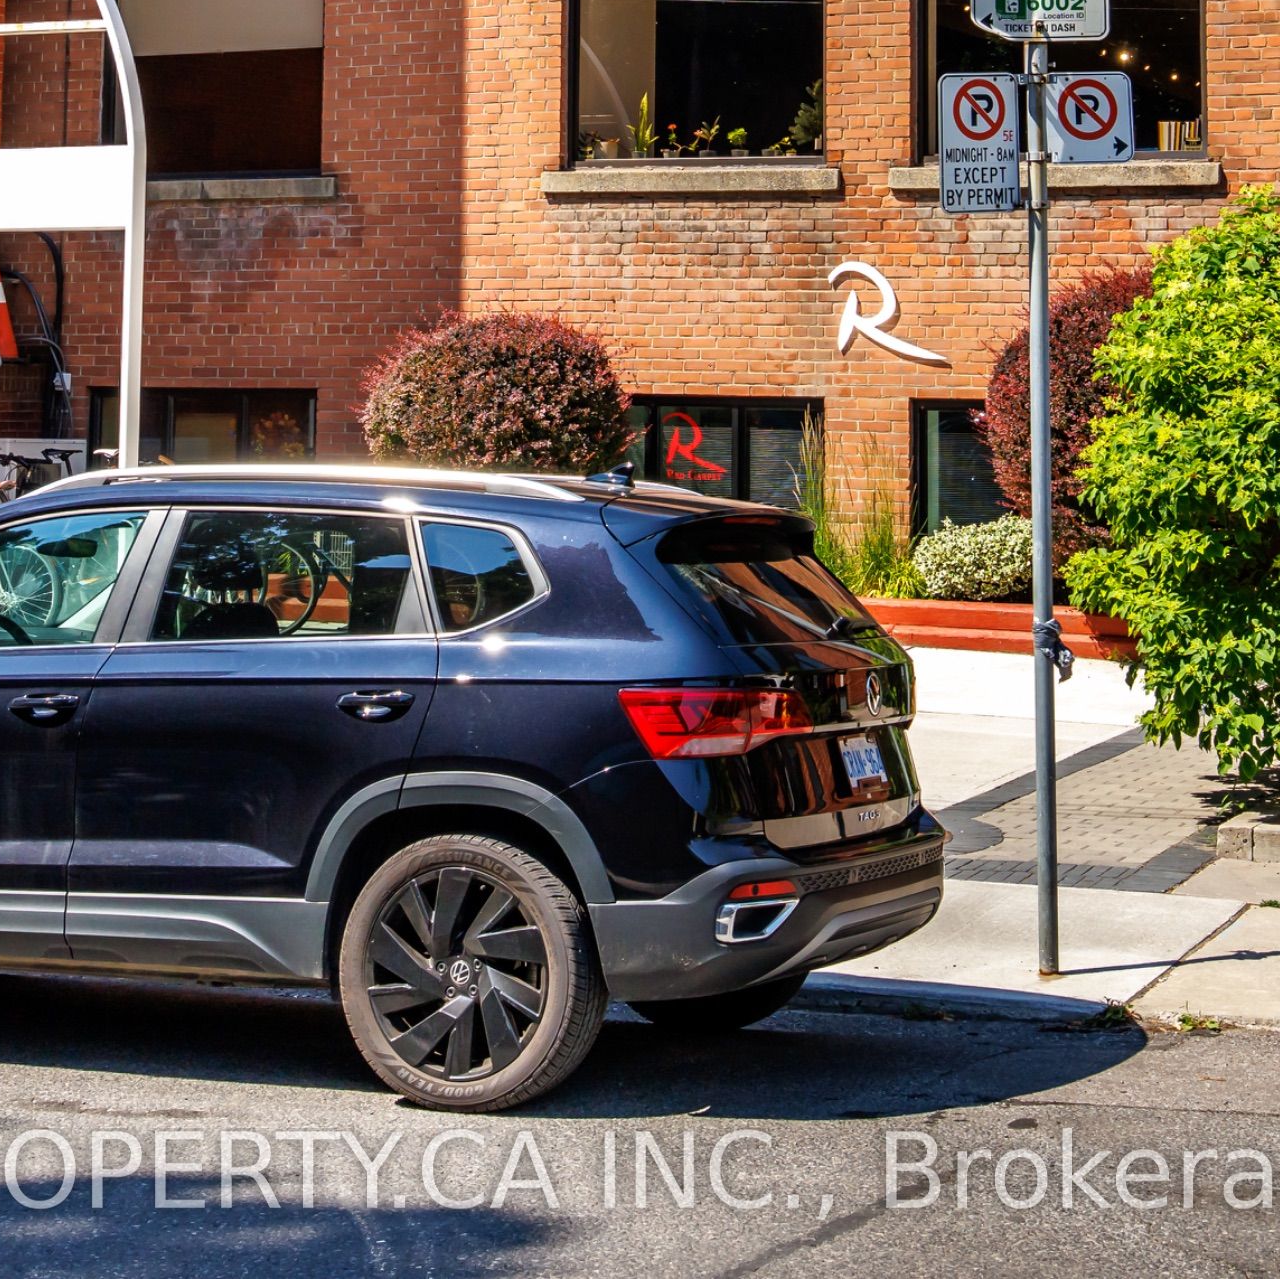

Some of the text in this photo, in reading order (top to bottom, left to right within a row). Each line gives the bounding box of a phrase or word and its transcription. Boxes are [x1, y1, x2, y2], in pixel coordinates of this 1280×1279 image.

[1005, 23, 1034, 33] TICKET
[1051, 23, 1076, 32] DASH
[945, 147, 988, 163] MIDNIGHT
[997, 147, 1014, 161] 8AM
[954, 167, 1006, 184] EXCEPT
[947, 188, 1015, 206] BY PERMIT
[828, 261, 947, 360] R
[859, 809, 880, 822] TAOS
